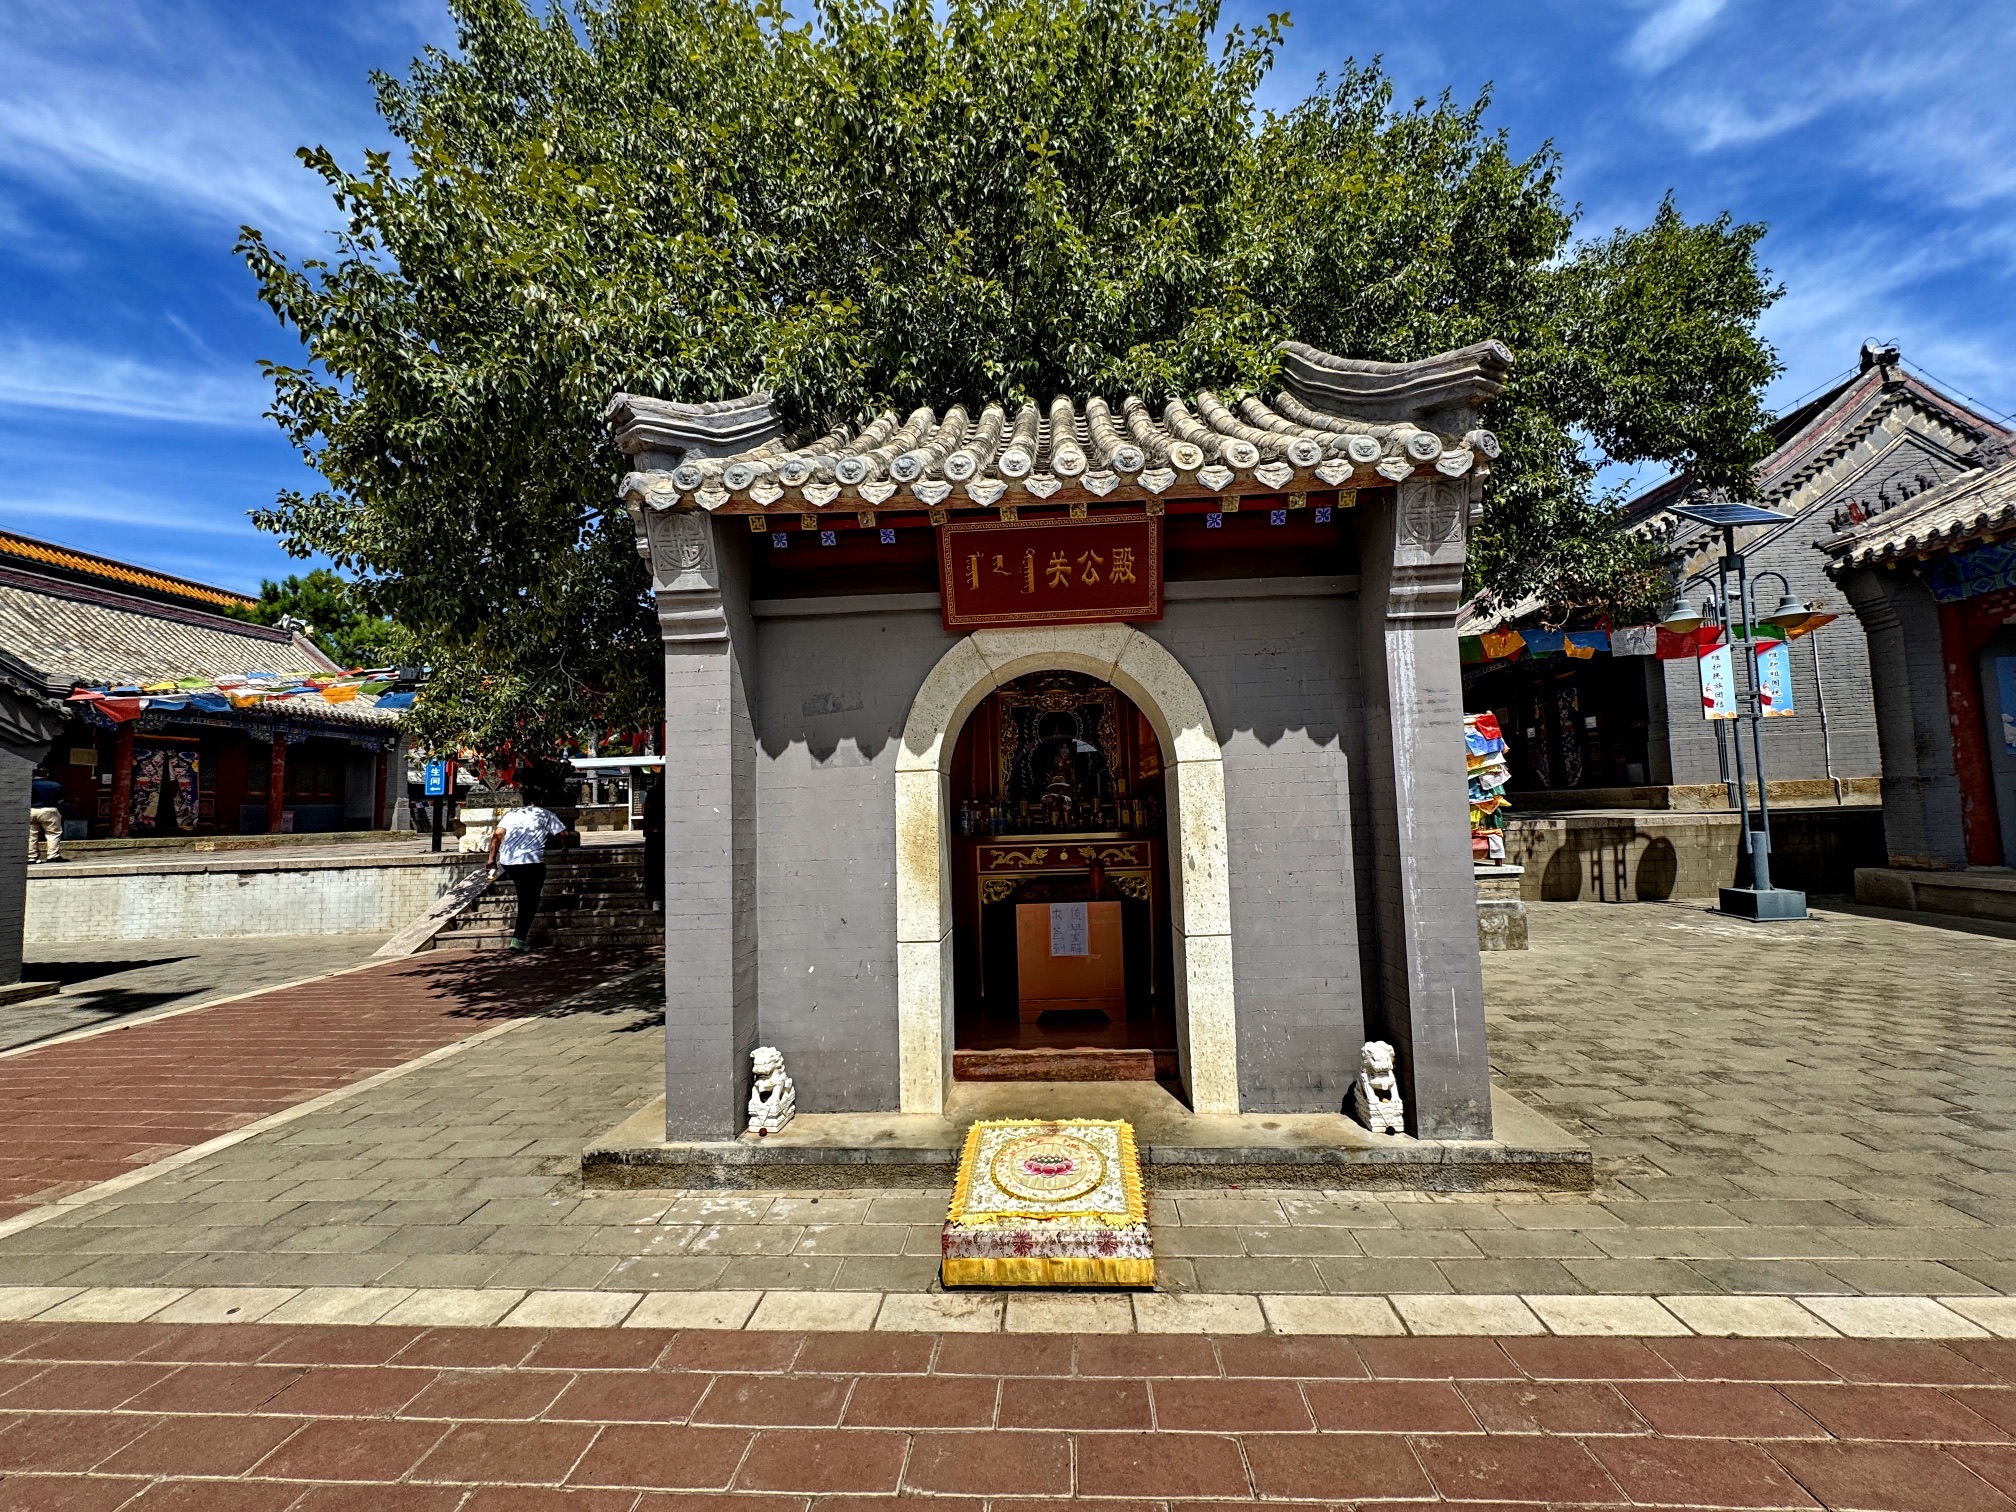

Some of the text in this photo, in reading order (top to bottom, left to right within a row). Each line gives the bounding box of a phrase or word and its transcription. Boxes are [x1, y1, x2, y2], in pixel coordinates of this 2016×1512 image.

[1046, 547, 1136, 588] 关公殿
[1711, 653, 1725, 708] 维护民族团结
[1768, 650, 1783, 703] 维护祖国统一
[430, 762, 442, 786] 生间
